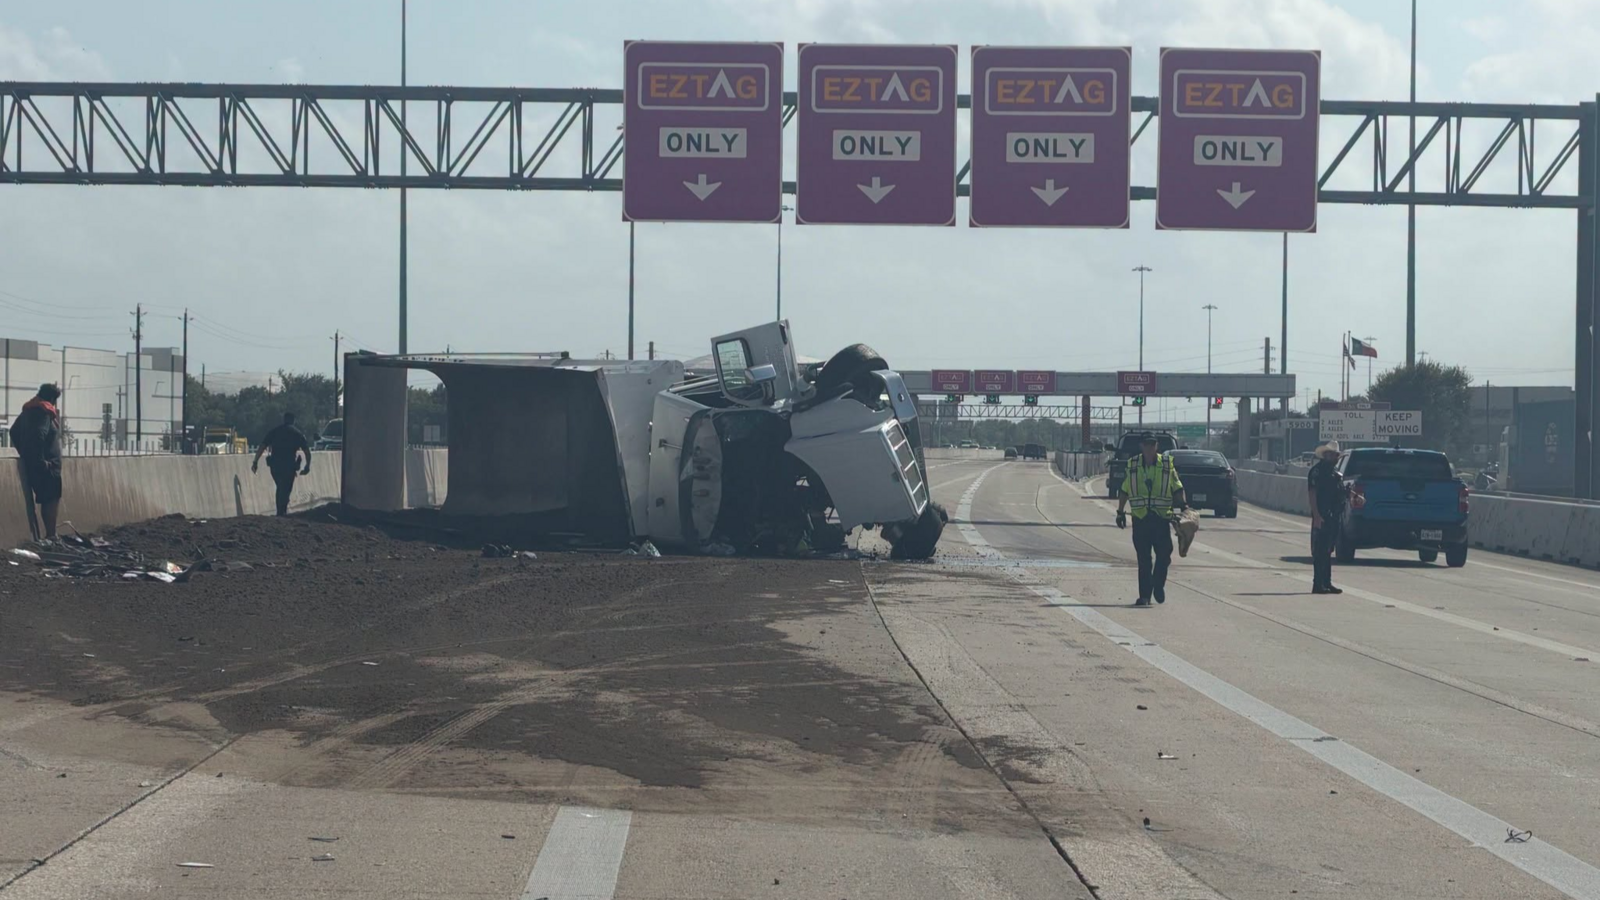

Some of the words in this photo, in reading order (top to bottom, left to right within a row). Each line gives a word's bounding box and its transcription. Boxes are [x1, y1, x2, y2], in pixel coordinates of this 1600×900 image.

[650, 68, 757, 99] EZTAG
[823, 71, 931, 102] EZTAG
[997, 74, 1105, 104] EZTAG
[1185, 78, 1293, 108] EZTAG
[666, 133, 739, 153] ONLY
[840, 135, 912, 156] ONLY
[1013, 138, 1086, 158] ONLY
[1201, 141, 1275, 161] ONLY
[1385, 413, 1412, 421] KEEP
[1378, 425, 1419, 433] MOVING
